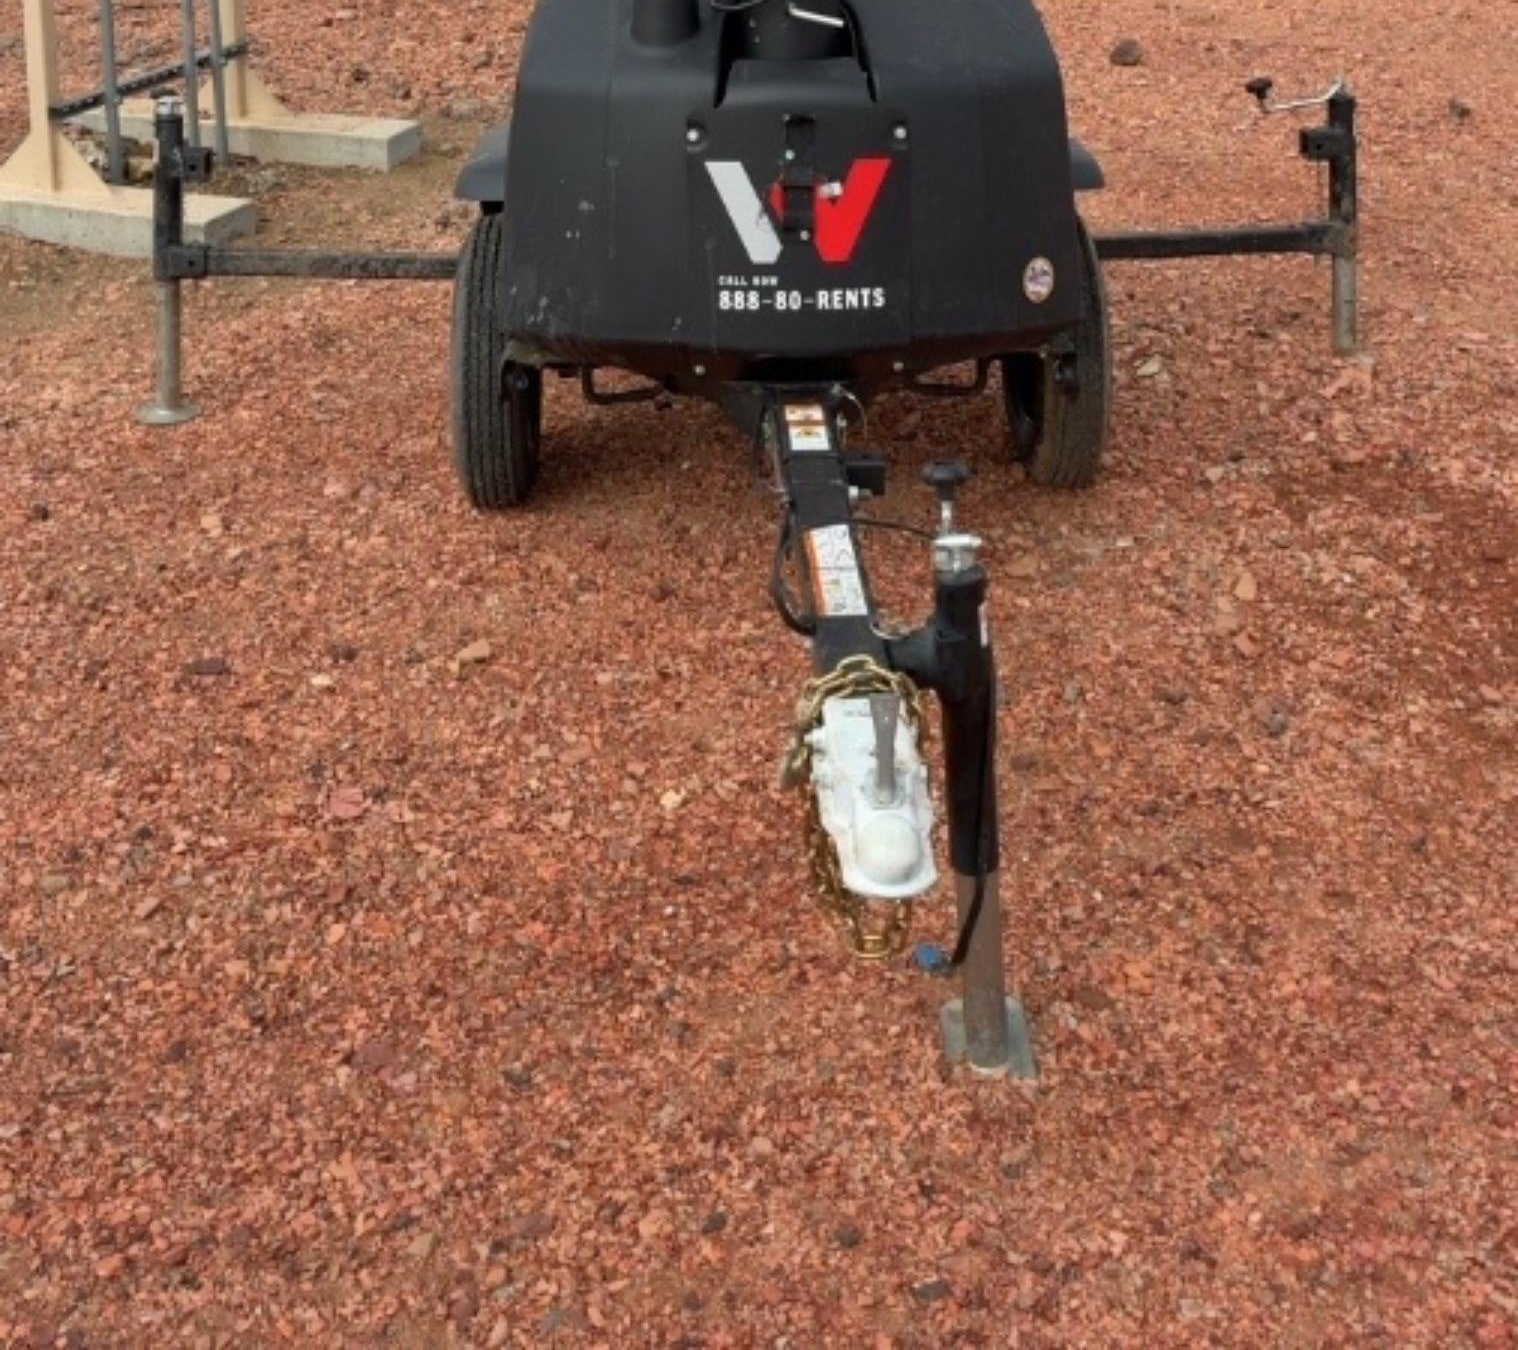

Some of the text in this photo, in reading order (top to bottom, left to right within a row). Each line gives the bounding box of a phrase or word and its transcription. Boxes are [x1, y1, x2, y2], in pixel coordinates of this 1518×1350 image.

[719, 275, 779, 286] CALL NOW
[719, 287, 886, 310] 888-80-RENTS
